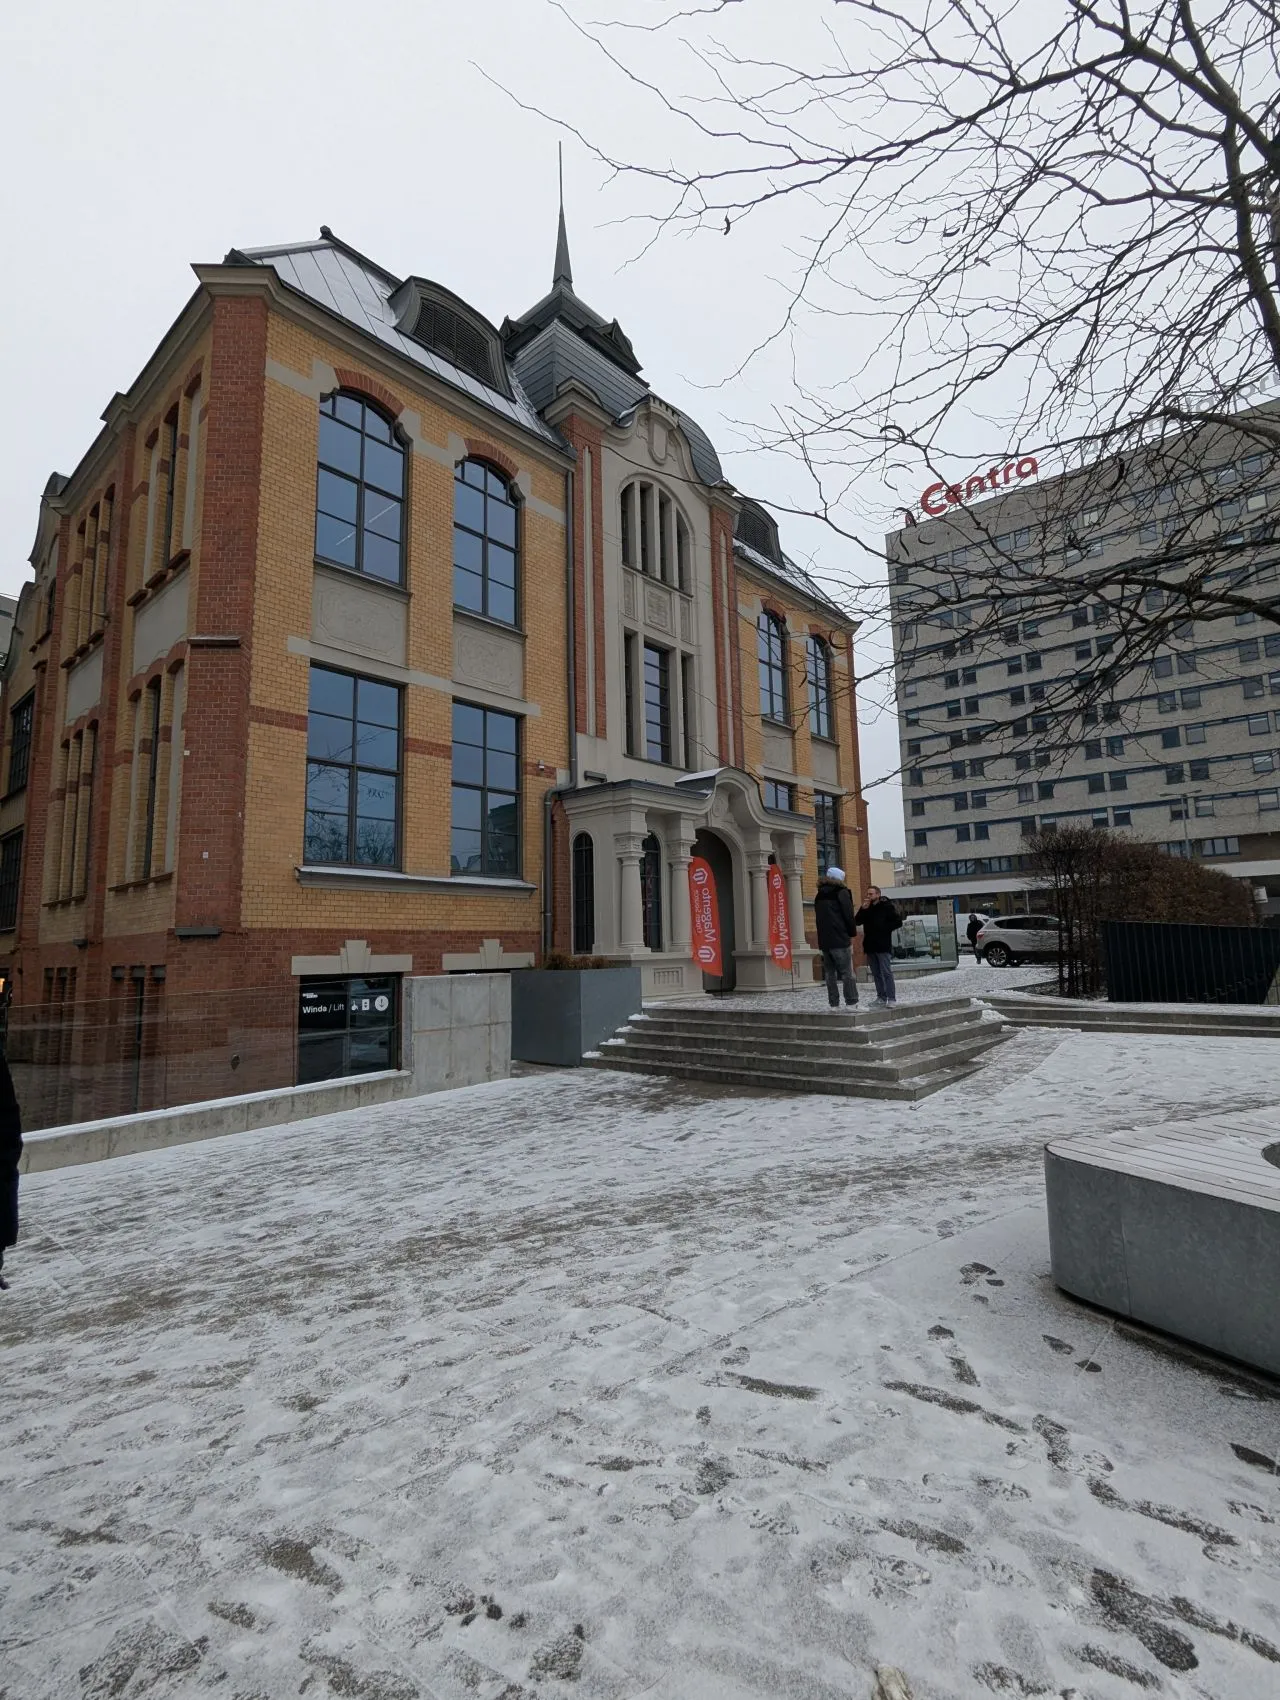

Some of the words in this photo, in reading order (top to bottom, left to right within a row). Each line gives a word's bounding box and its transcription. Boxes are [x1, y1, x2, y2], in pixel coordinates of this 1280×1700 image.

[920, 456, 1038, 515] Centra
[302, 1005, 327, 1013] Winda
[333, 1003, 344, 1011] Lift
